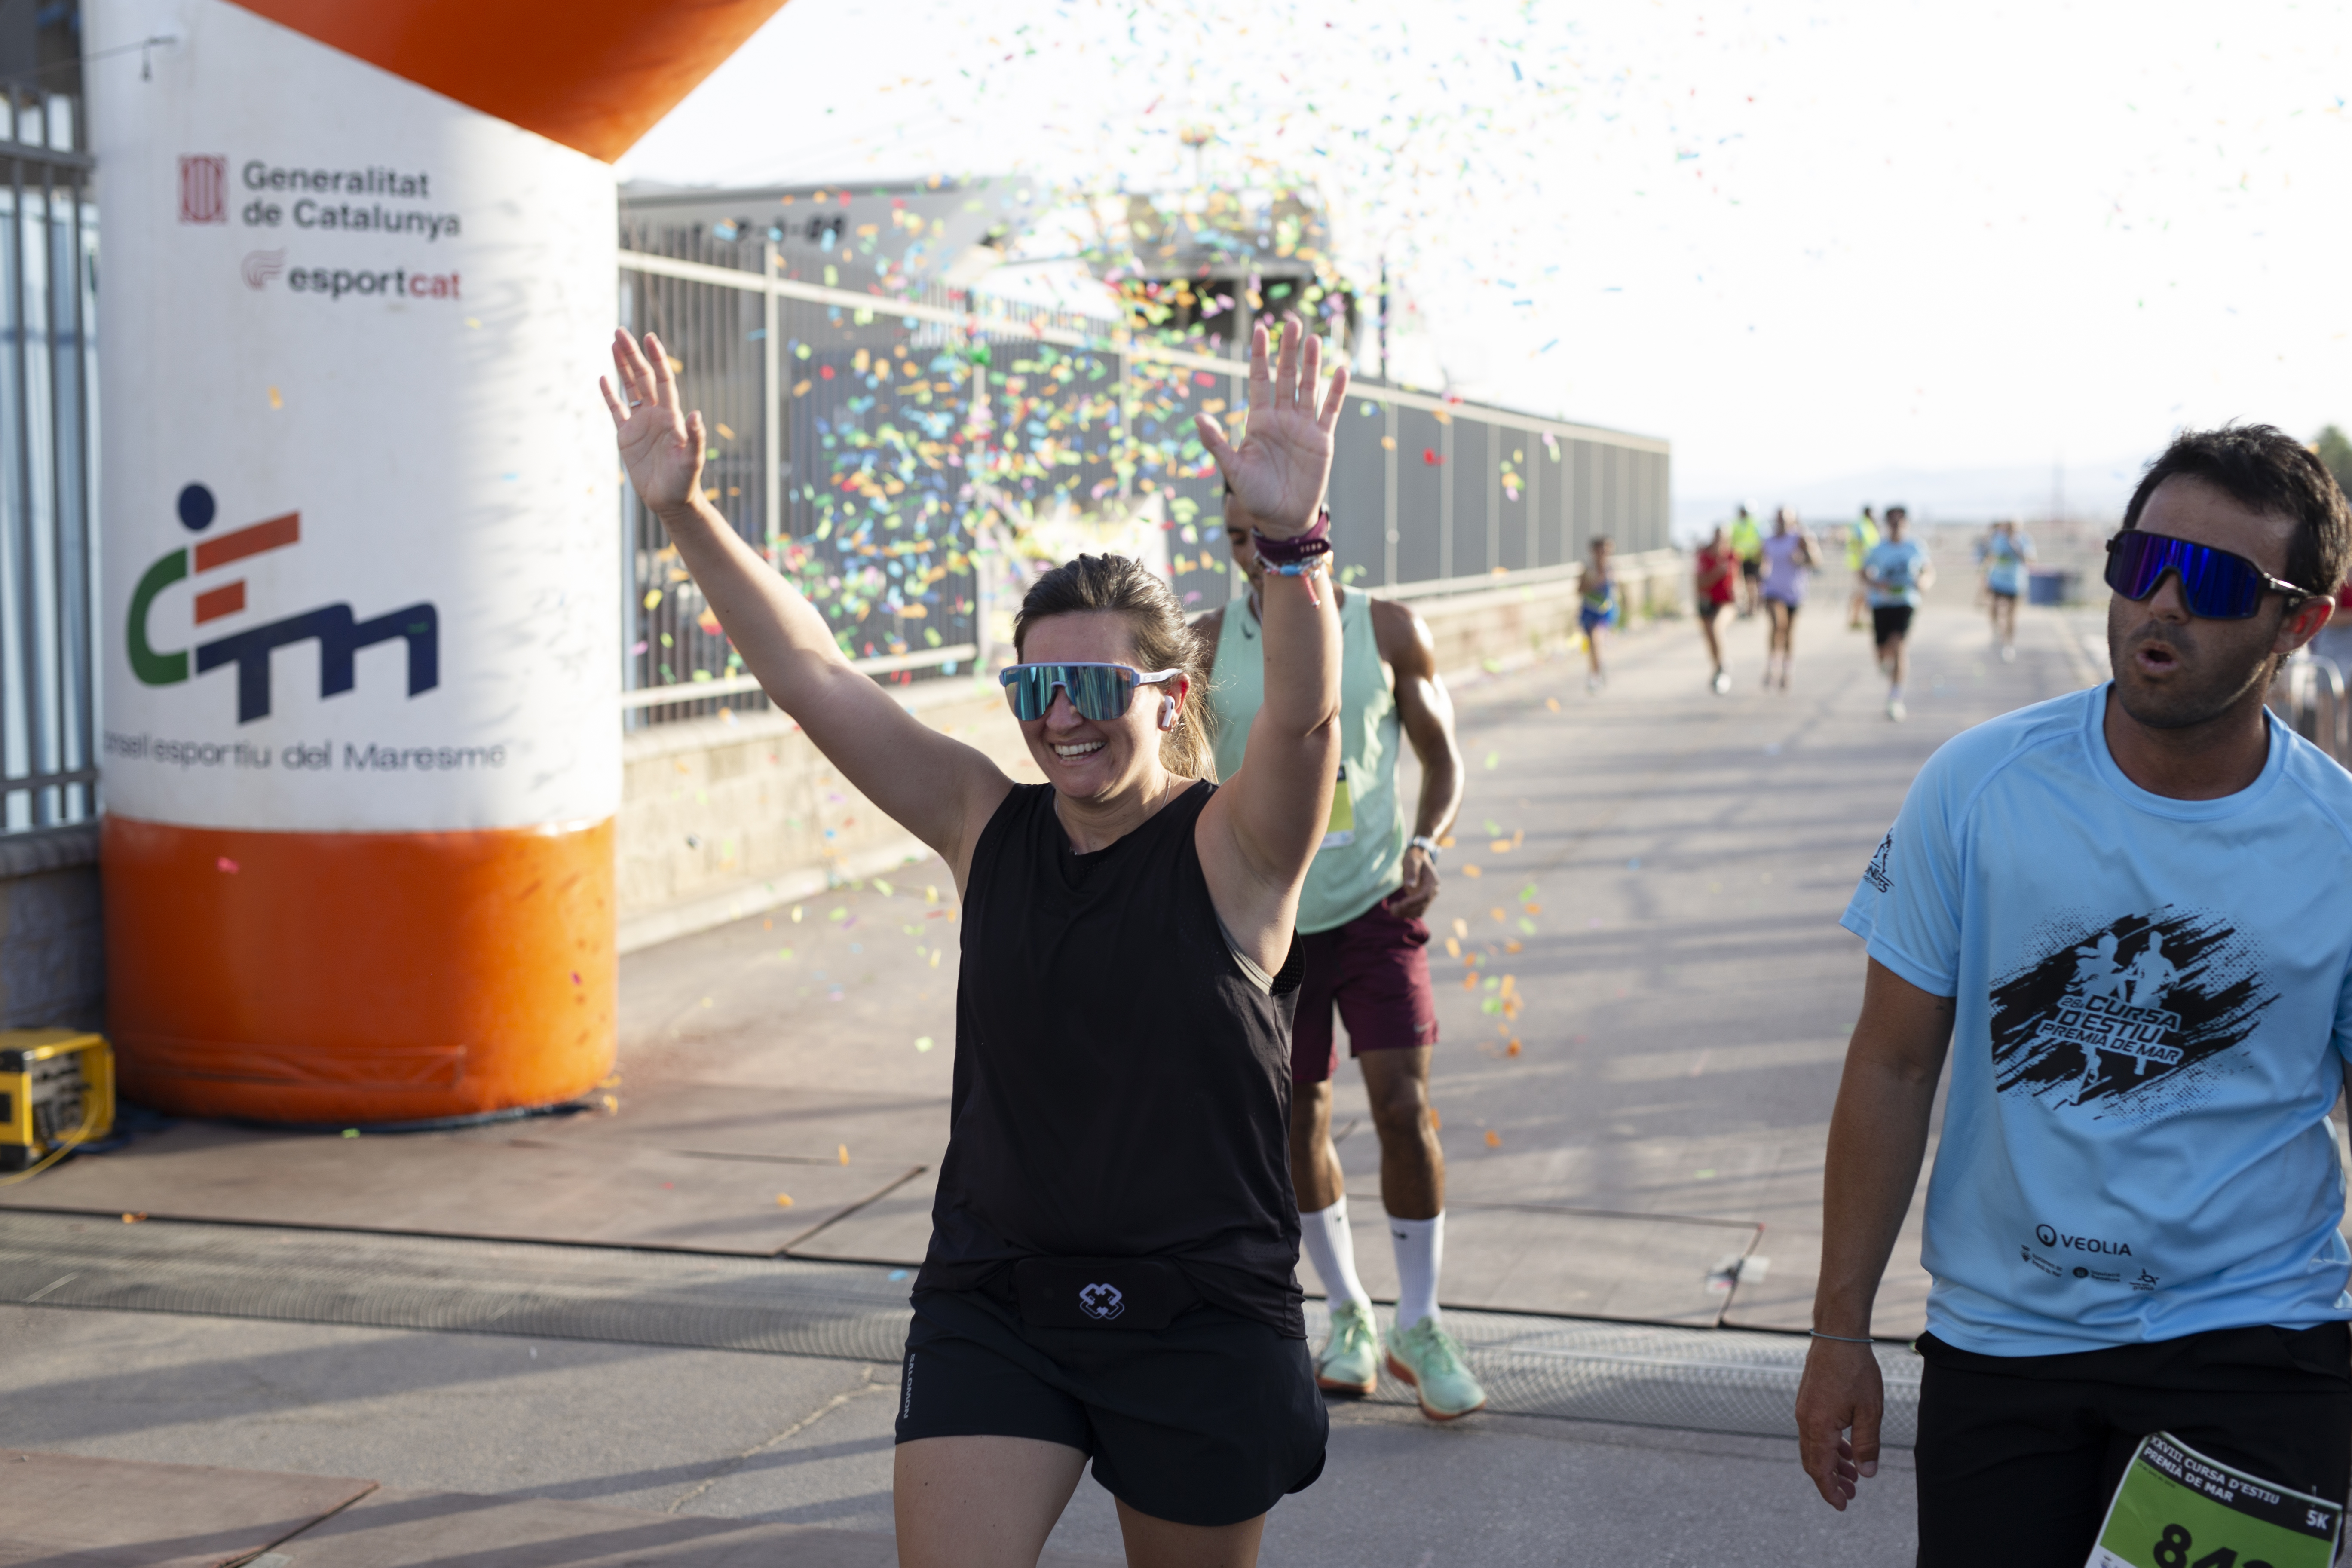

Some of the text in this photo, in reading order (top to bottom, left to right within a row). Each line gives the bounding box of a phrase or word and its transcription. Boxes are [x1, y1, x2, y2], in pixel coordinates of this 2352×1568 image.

[242, 160, 429, 199] Generalitat
[242, 199, 462, 242] de Catalunya
[288, 267, 462, 301] esportcat
[153, 737, 272, 772] esportiu
[282, 740, 332, 771] del
[344, 741, 507, 772] Maresme
[2058, 1010, 2162, 1043] D'ESTIU
[2086, 994, 2178, 1031] CURSA
[2110, 1038, 2138, 1053] DE
[2136, 1044, 2180, 1062] MAR
[2061, 1234, 2133, 1257] VEOLIA
[904, 1354, 916, 1419] SALOMON
[2143, 1446, 2183, 1478] PREMIÀ
[2184, 1472, 2203, 1488] DE
[2203, 1482, 2234, 1502] MAR
[2150, 1435, 2184, 1463] XXVIII
[2184, 1458, 2226, 1485] CURSA
[2228, 1478, 2280, 1504] D'ESTIU
[2305, 1508, 2331, 1530] 5K
